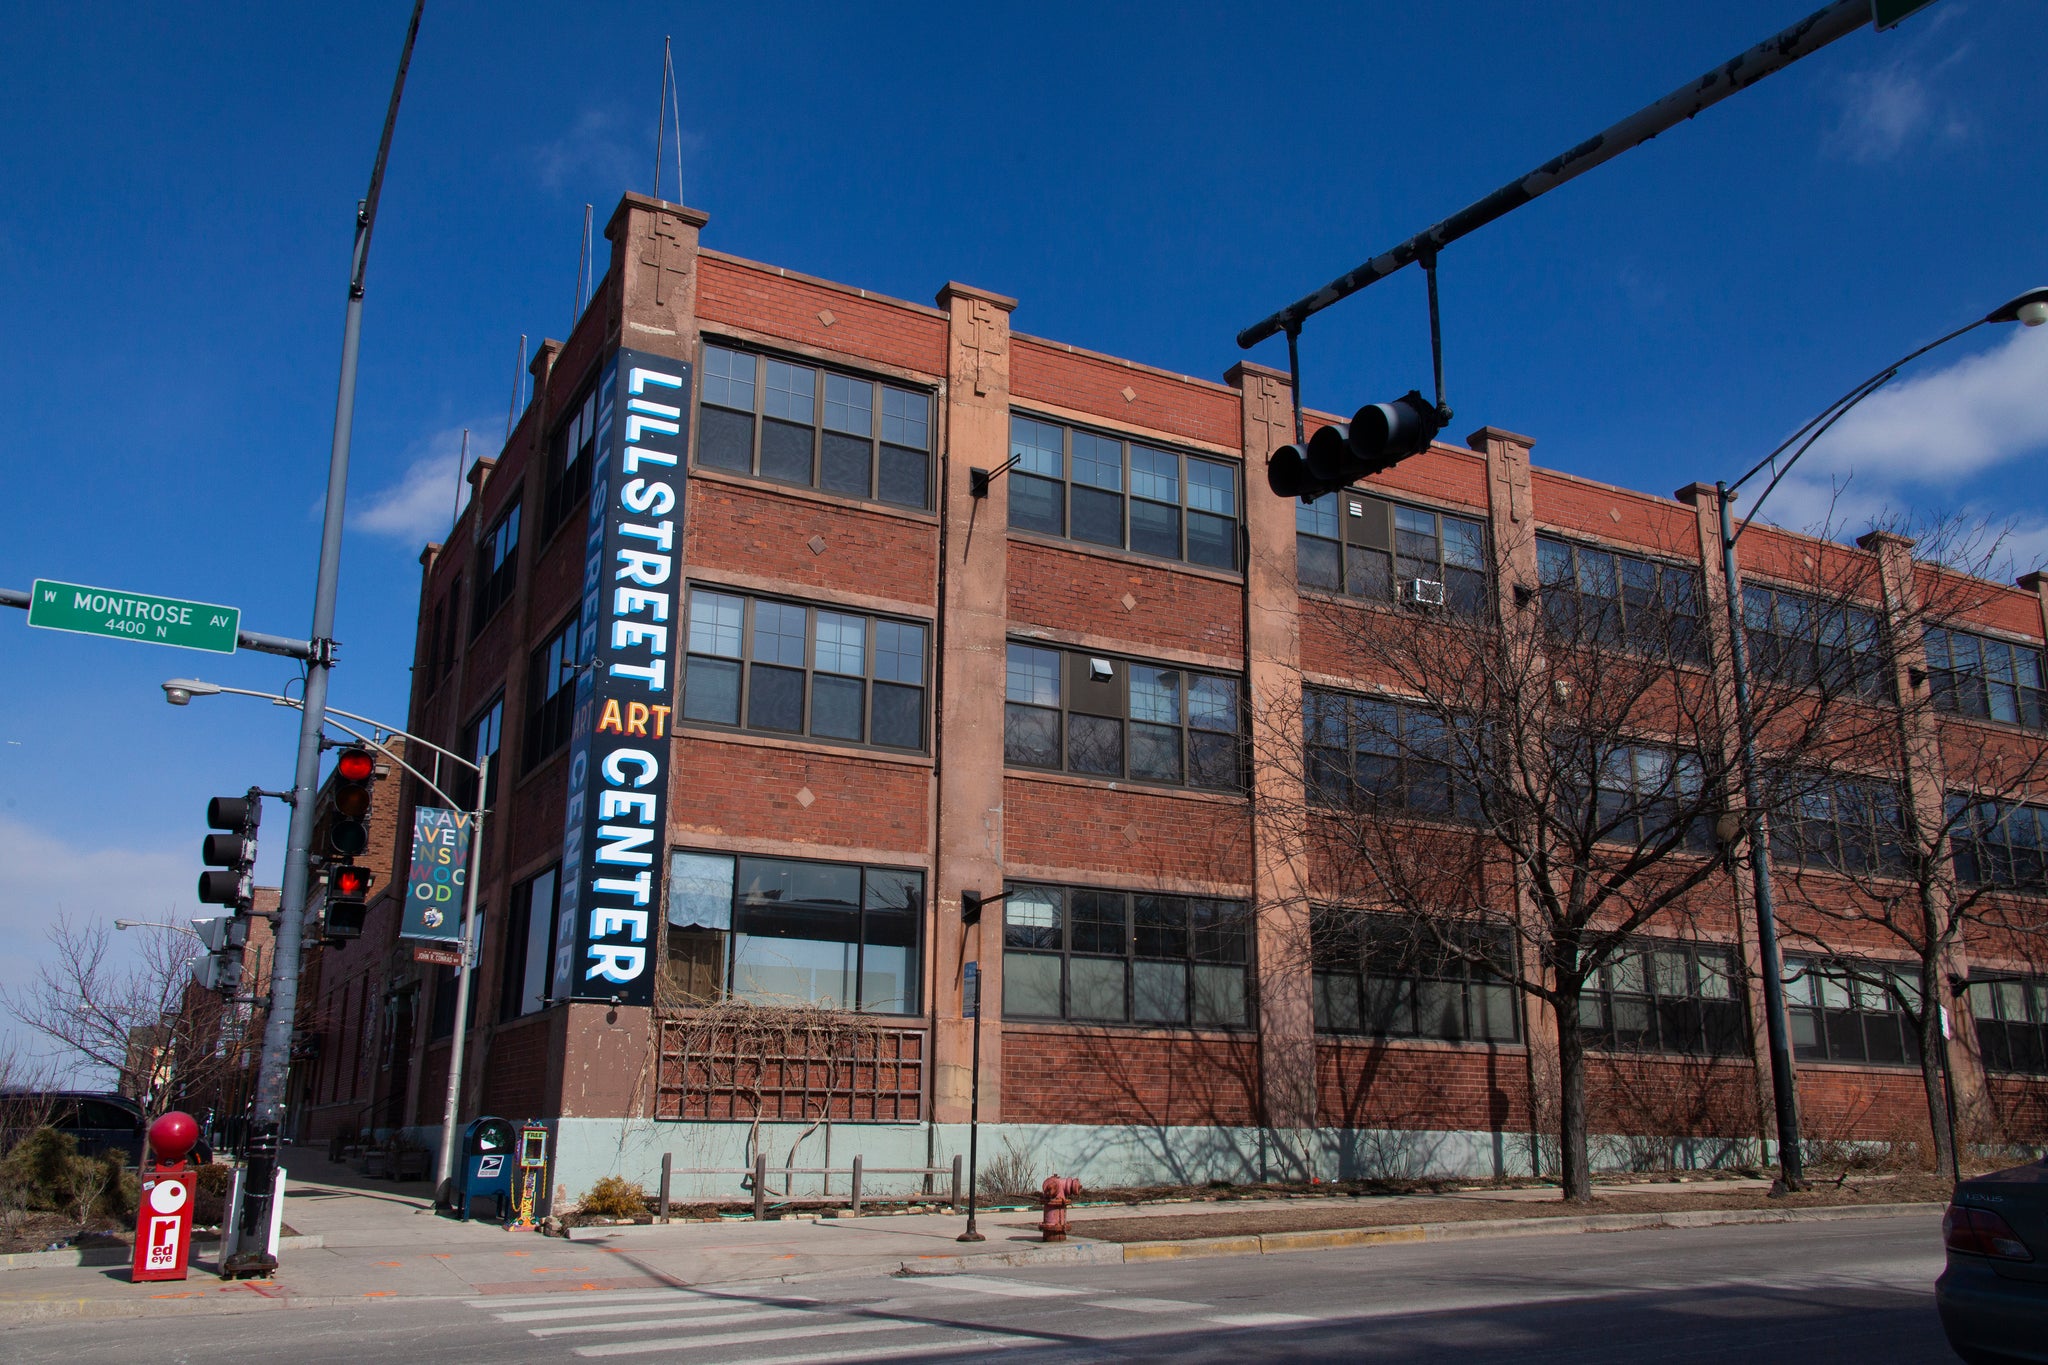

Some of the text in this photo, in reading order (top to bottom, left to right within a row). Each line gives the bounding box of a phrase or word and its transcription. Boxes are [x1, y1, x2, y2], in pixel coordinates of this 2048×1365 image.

[609, 367, 682, 692] LILLSTREET
[44, 590, 229, 628] W MONTROSE AV
[105, 619, 167, 638] 4400 N
[597, 698, 671, 739] ART
[420, 808, 469, 829] RAV
[555, 749, 587, 985] CENTER
[586, 748, 659, 984] CENTER
[1966, 1192, 2004, 1202] LEXUS
[151, 1255, 173, 1265] eye
